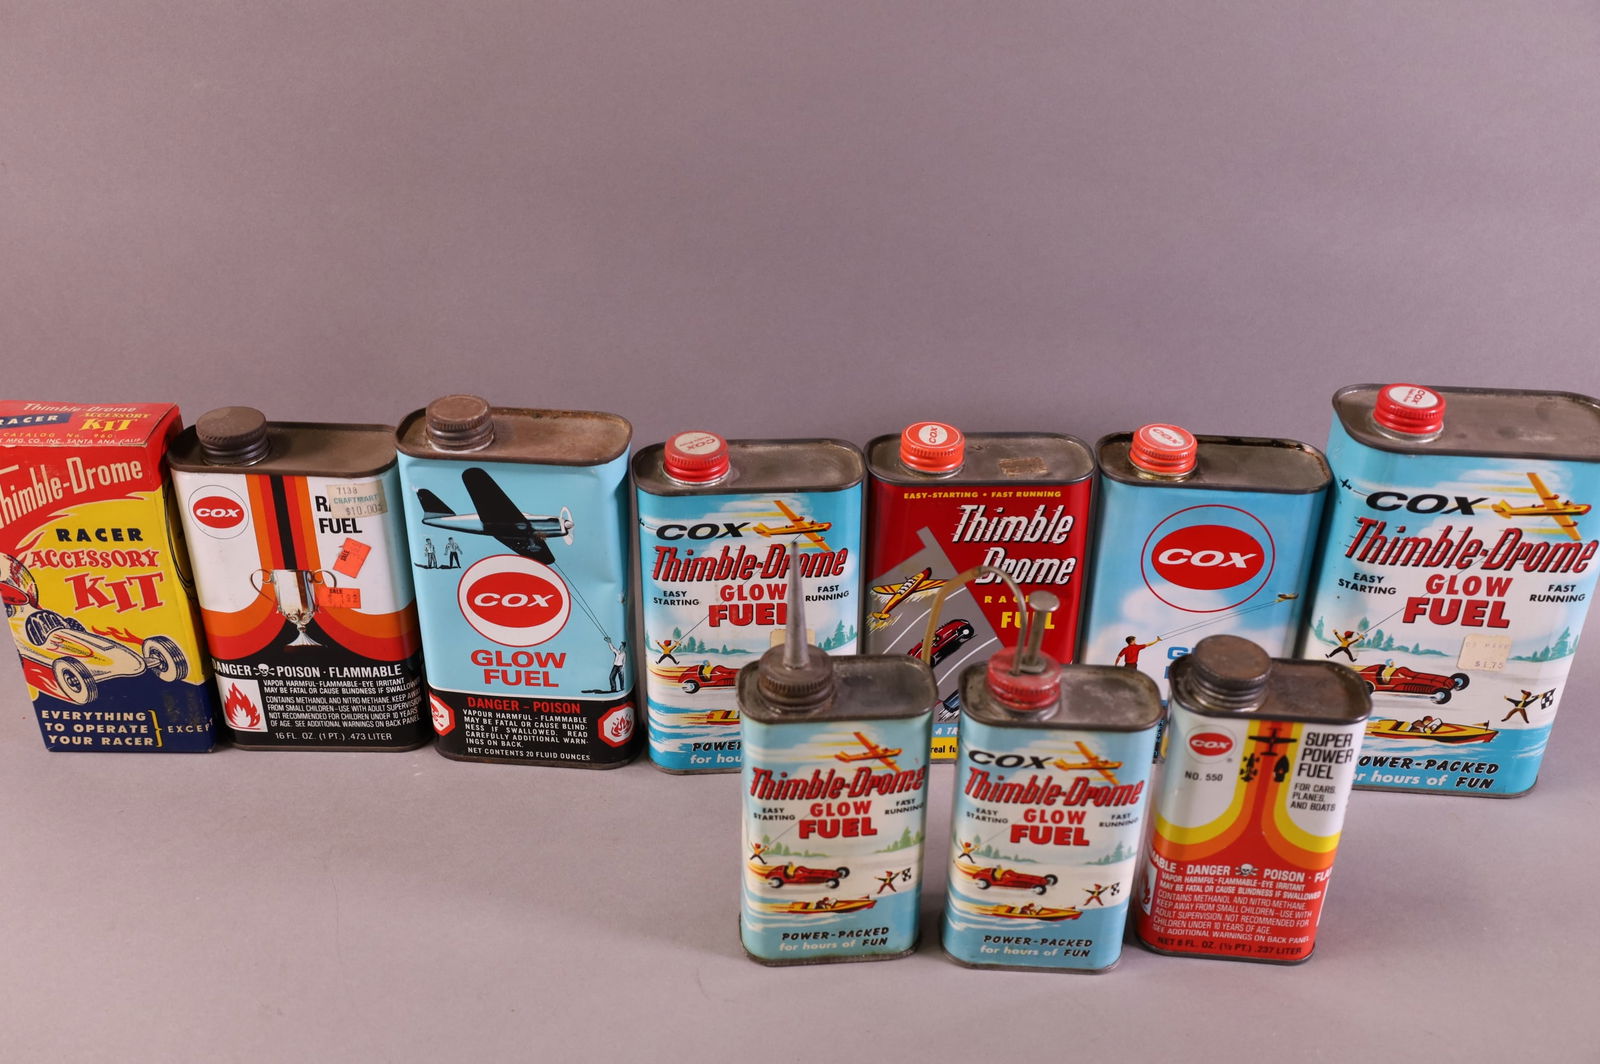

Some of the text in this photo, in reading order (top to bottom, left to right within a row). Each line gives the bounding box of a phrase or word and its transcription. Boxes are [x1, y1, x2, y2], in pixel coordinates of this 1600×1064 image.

[79, 418, 132, 432] KIT
[903, 490, 1062, 500] EASY-STARTING FAST RUNNING
[1365, 491, 1490, 516] COX
[195, 508, 240, 518] COX
[318, 518, 363, 534] FUEL
[951, 503, 1075, 544] Thimble
[56, 528, 144, 542] RACER
[656, 522, 750, 540] COX
[1344, 516, 1600, 574] Thimble-Drome
[28, 549, 159, 569] ACCESSORY
[1157, 548, 1257, 569] COX
[974, 547, 1077, 585] Drome
[1353, 573, 1385, 584] EASY
[1425, 574, 1513, 597] GLOW
[64, 572, 164, 613] KIT
[720, 584, 787, 601] GLOW
[817, 584, 840, 593] FAST
[1338, 578, 1397, 595] STARTING
[1547, 584, 1576, 593] FAST
[474, 592, 555, 608] COX
[663, 590, 687, 598] EASY
[805, 590, 850, 602] RUNNING
[1529, 593, 1585, 603] RUNNING
[653, 597, 700, 606] STARTING
[1402, 597, 1513, 629] FUEL
[470, 649, 567, 669] GLOW
[276, 665, 321, 678] POISON
[328, 664, 402, 678] FLAMMABLE
[483, 669, 560, 688] FUEL
[320, 687, 339, 695] CAUSE
[342, 687, 376, 695] BLINDNESS
[467, 696, 580, 714] DANGER POISON
[41, 710, 147, 721] EVERYTHING
[462, 709, 492, 718] VAPOUR
[540, 714, 587, 724] FLAMMABLE
[45, 723, 66, 732] TO
[73, 723, 148, 733] OPERATE
[496, 719, 518, 727] FATAL
[275, 732, 284, 740] 16
[368, 732, 392, 740] LITER
[465, 723, 485, 731] NESS
[491, 725, 499, 733] IF
[567, 730, 588, 738] READ
[465, 731, 509, 740] CAREFULLY
[512, 734, 560, 743] ADDITIONAL
[48, 735, 153, 746] YOUR RACER
[501, 740, 524, 748] BACK.
[1190, 740, 1231, 750] COX
[1305, 732, 1353, 747] SUPER
[484, 748, 524, 757] CONTENTS
[536, 751, 558, 759] FLUID
[560, 752, 590, 760] OUNCES
[690, 754, 712, 764] for
[968, 750, 1054, 770] COX
[1301, 748, 1353, 764] POWER
[1297, 763, 1334, 780] FUEL
[1356, 756, 1500, 775] OWER-PACKED
[750, 765, 927, 801] Thimble-Drome
[1205, 773, 1224, 782] 550
[1370, 770, 1495, 789] hours of FUN
[963, 767, 1145, 807] Thimble-Drome
[1294, 782, 1310, 793] FOR
[810, 800, 872, 817] GLOW
[895, 798, 916, 807] FAST
[1290, 801, 1336, 812] AND BOATS
[753, 812, 796, 821] STARTING
[966, 811, 1009, 824] STARTING
[976, 807, 998, 816] EASY
[1023, 808, 1087, 825] GLOW
[1111, 812, 1132, 820] FAST
[798, 817, 878, 840] FUEL
[1098, 817, 1139, 828] RUNNING
[1009, 824, 1090, 847] FUEL
[1186, 864, 1231, 876] DANGER
[1263, 868, 1305, 882] POISON
[782, 926, 890, 941] POWER-PACKED
[779, 937, 889, 951] for hours of FUN
[983, 935, 1093, 947] POWER-PACKED
[980, 945, 1091, 958] for hours of FUN
